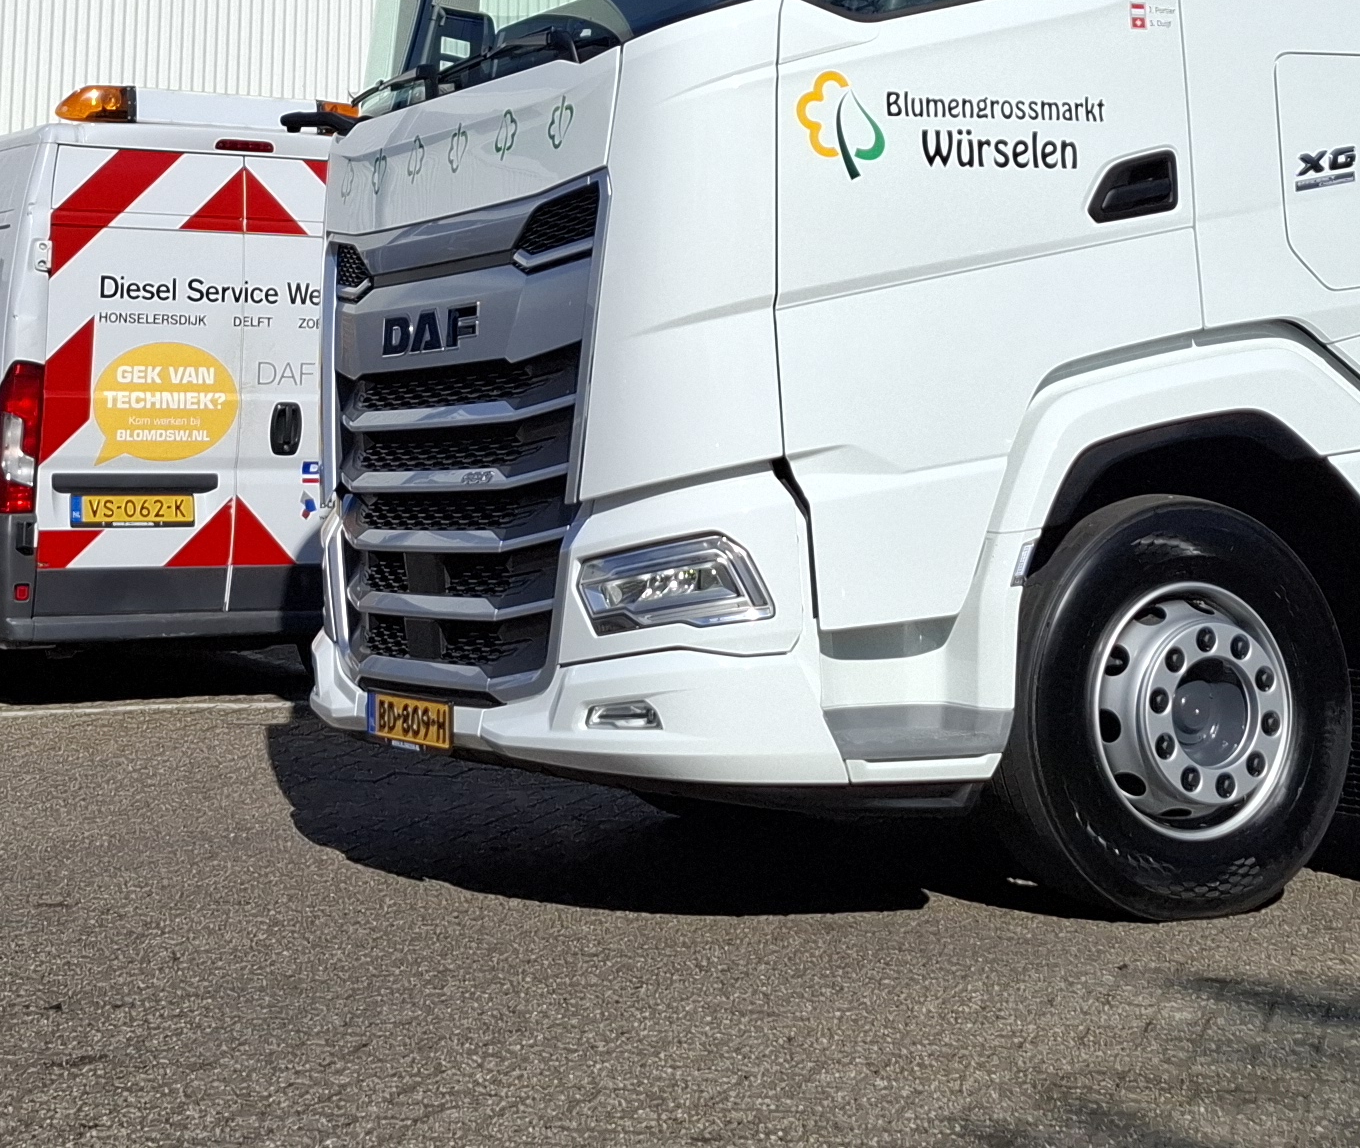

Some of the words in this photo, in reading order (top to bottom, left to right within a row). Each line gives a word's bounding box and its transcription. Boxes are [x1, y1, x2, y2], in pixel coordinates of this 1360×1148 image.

[886, 90, 1106, 122] Blumengrossmarkt
[921, 128, 1078, 170] Würselen
[1296, 145, 1356, 177] XG
[100, 275, 177, 301] Diesel
[187, 278, 279, 304] Service
[99, 312, 208, 327] HONSELERSDIJK
[233, 316, 274, 328] DELFT
[382, 300, 481, 358] DAF
[116, 365, 163, 384] GEK
[168, 366, 215, 385] VAN
[257, 361, 316, 386] DAF
[103, 390, 226, 410] TECHNIEK?
[128, 416, 151, 426] Kom
[153, 416, 187, 426] werken
[189, 415, 201, 428] bij
[116, 429, 211, 442] BLOMDSW.NL
[88, 498, 186, 518] VS-062-K
[378, 698, 447, 744] BD-809-H
